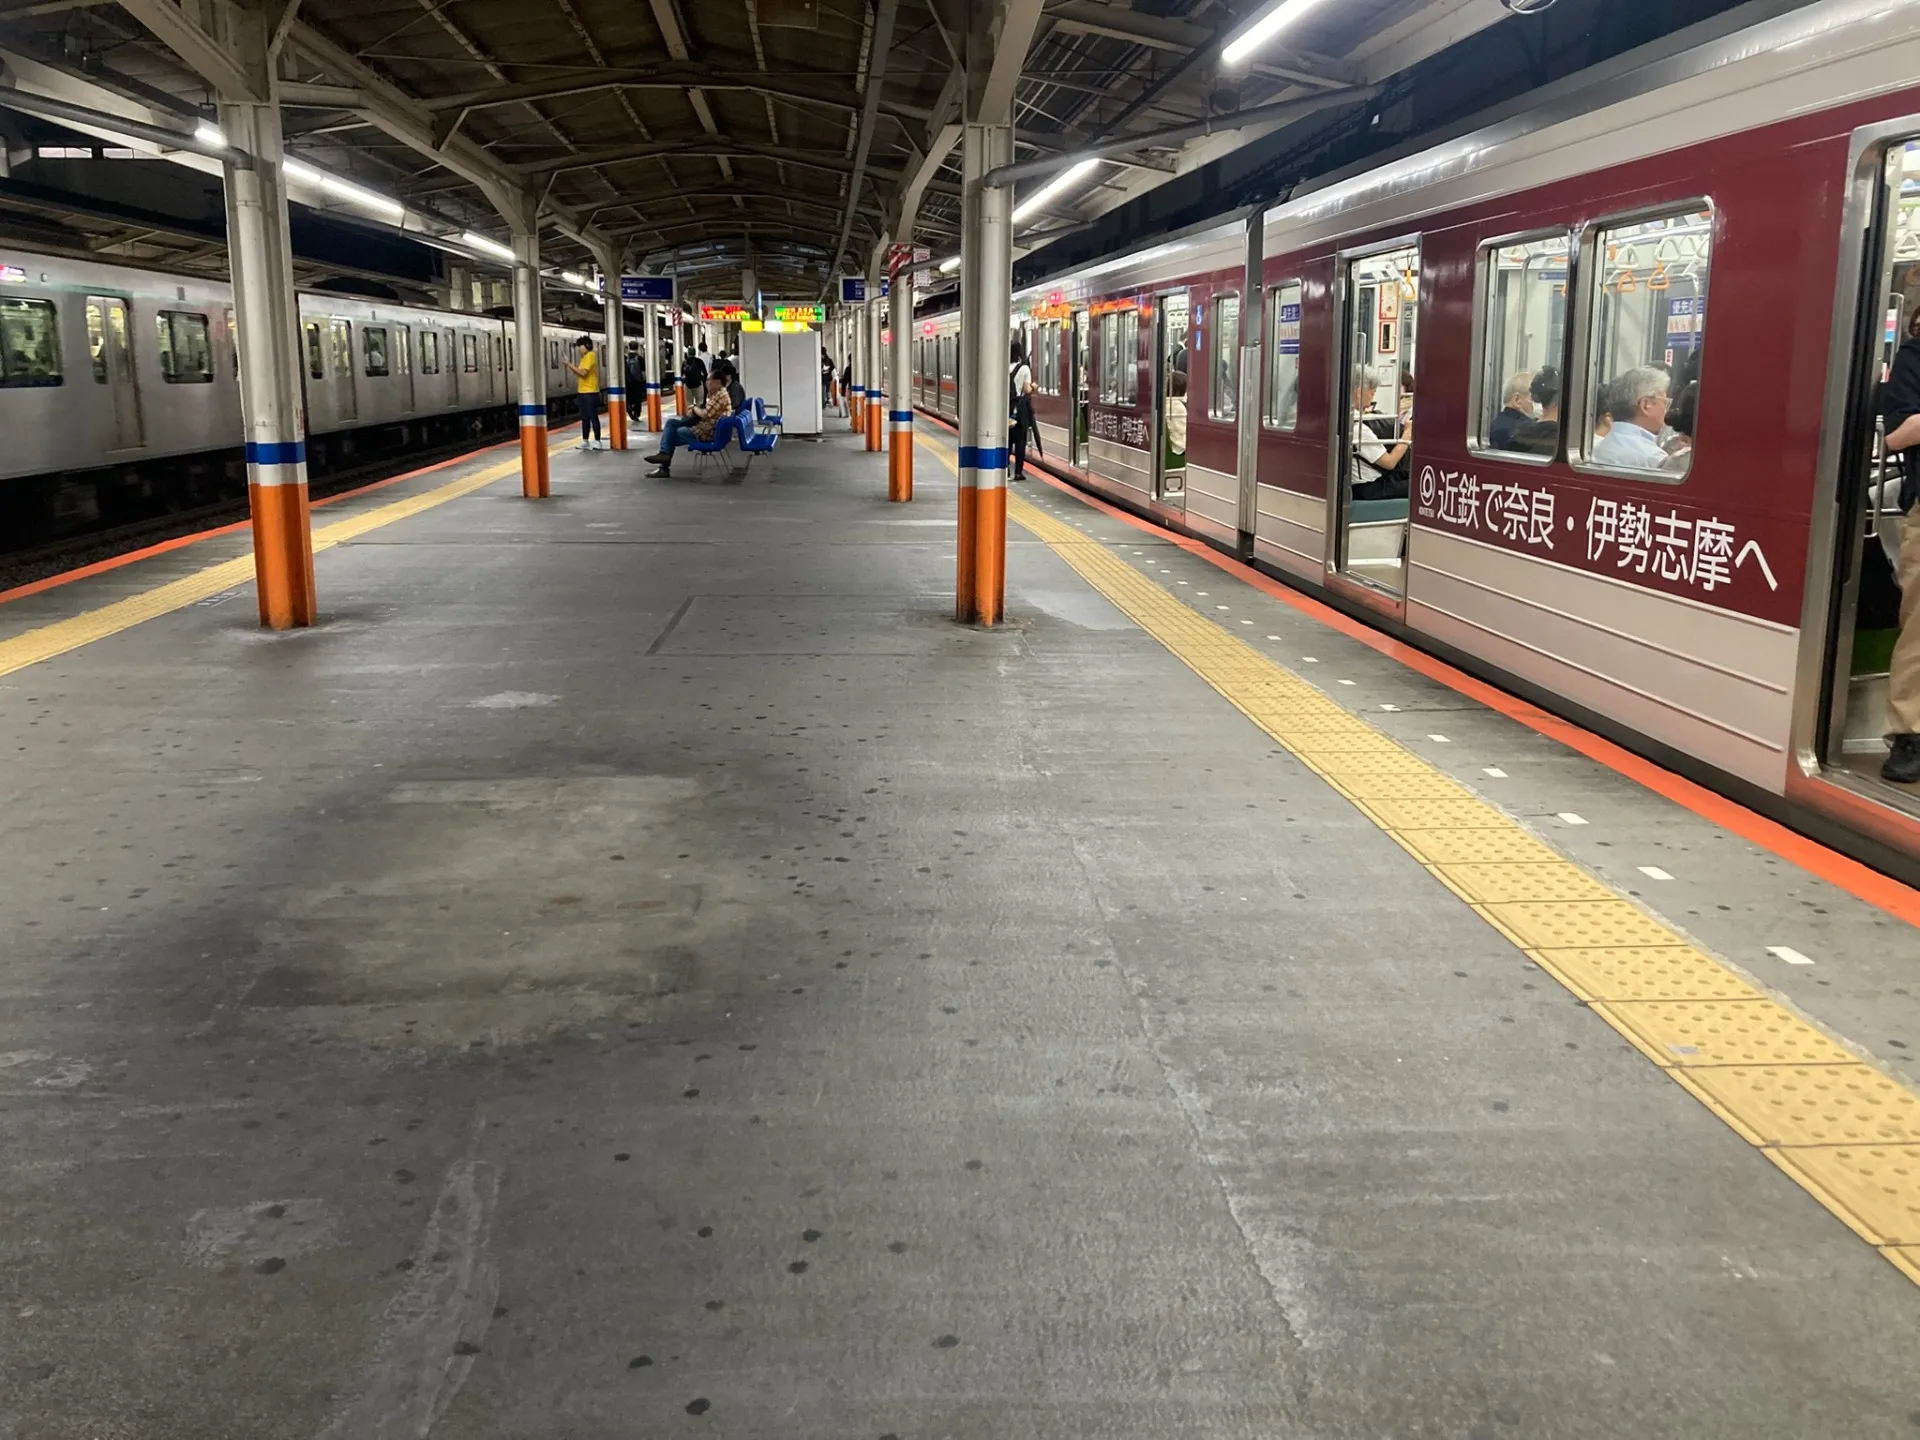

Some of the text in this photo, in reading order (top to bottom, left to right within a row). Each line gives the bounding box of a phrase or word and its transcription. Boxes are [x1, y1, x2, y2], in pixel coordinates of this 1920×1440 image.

[1436, 469, 1779, 592] 近鉄で奈良・伊勢志摩へ
